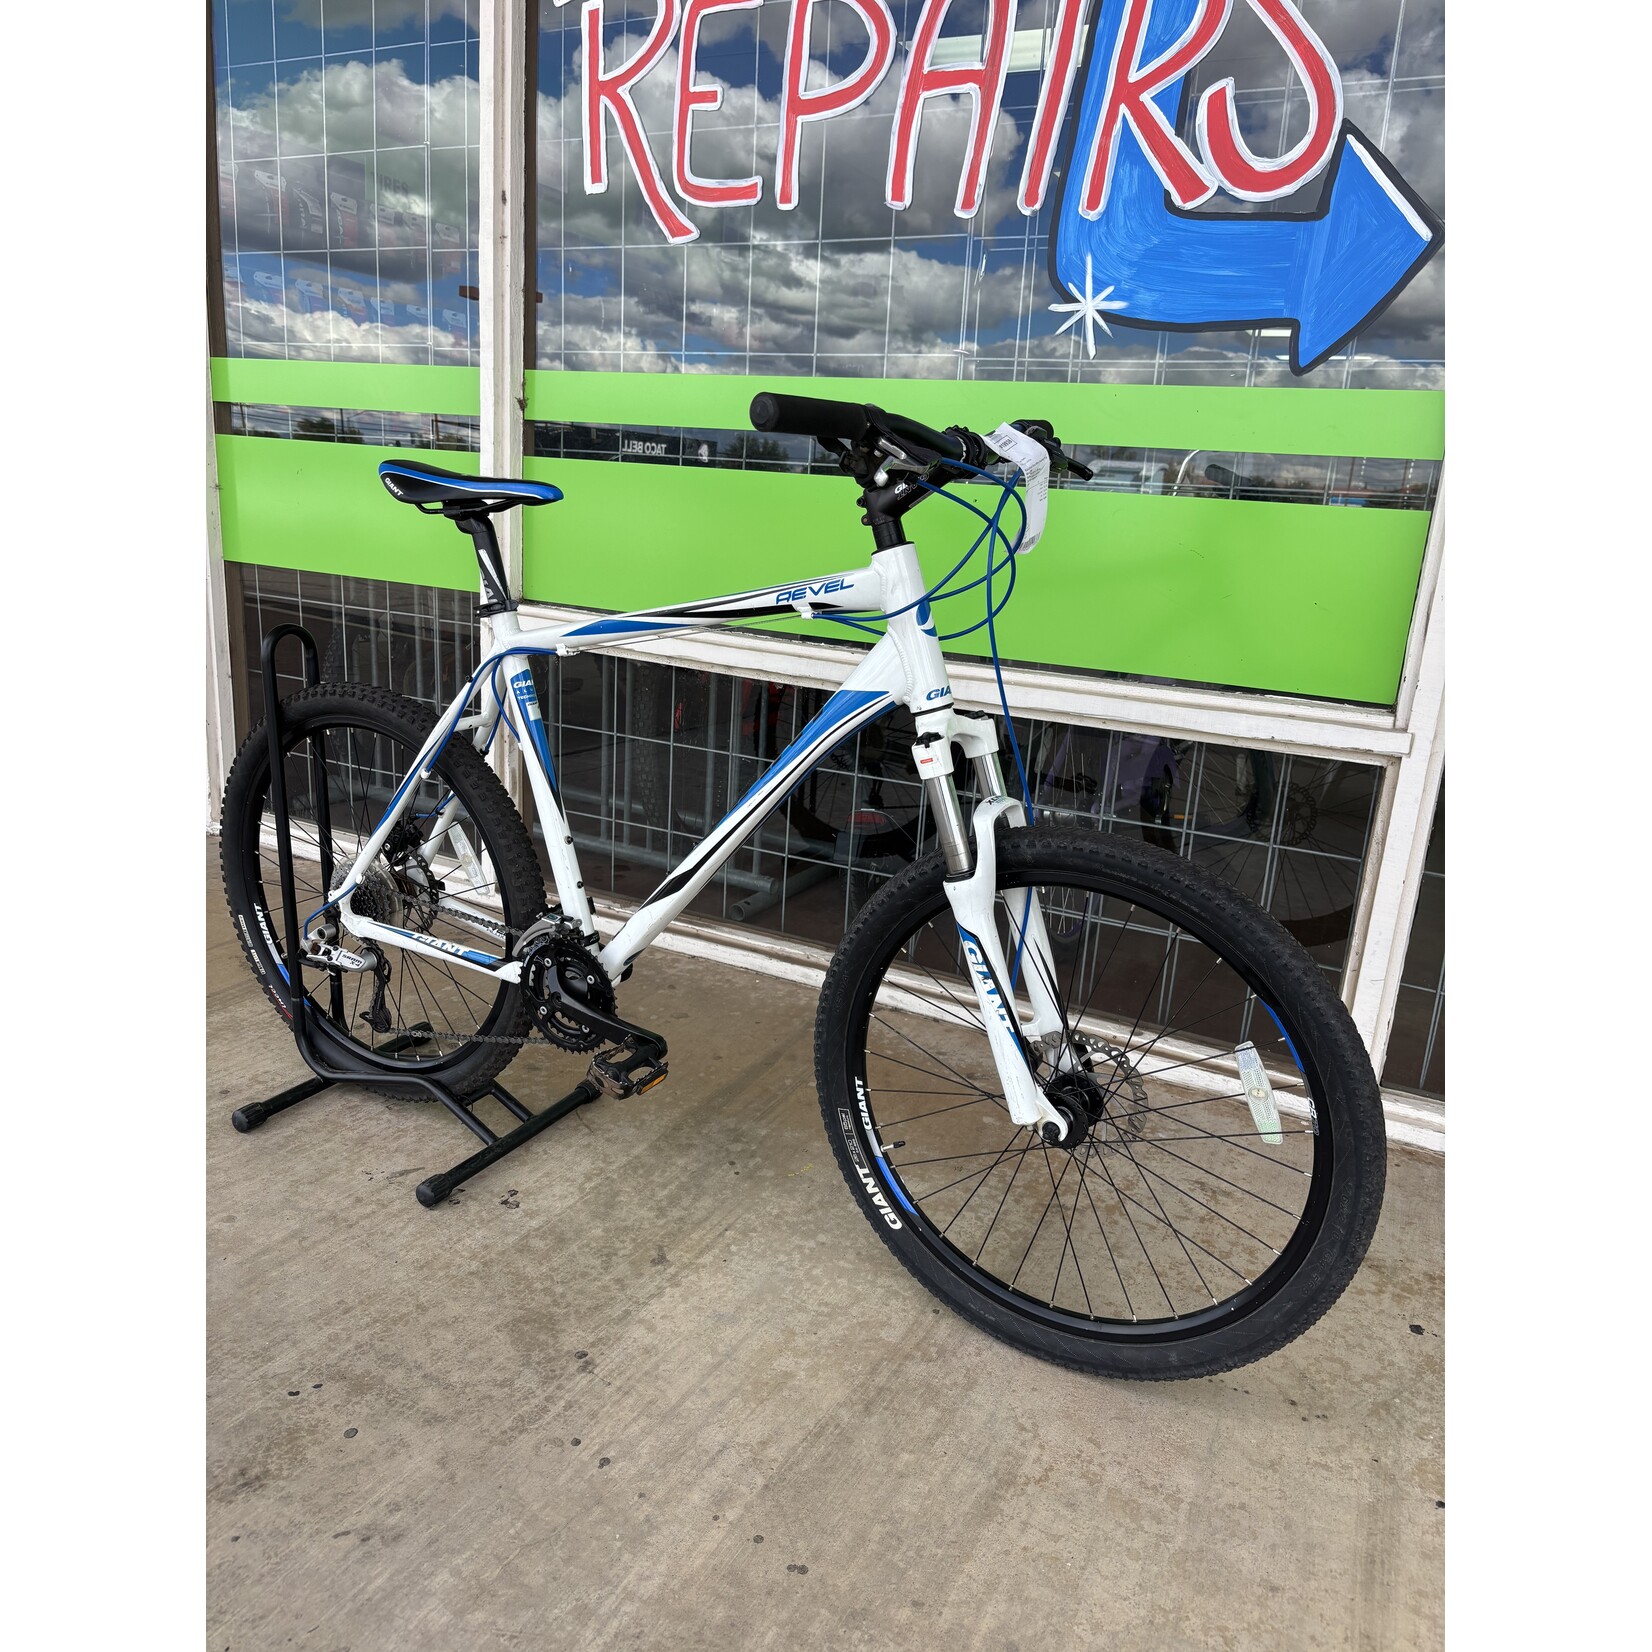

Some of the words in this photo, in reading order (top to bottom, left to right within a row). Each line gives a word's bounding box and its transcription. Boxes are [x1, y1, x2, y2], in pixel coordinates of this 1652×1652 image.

[553, 0, 1345, 243] REPAIRS
[385, 477, 404, 497] GIANT
[775, 578, 854, 604] REVEL
[254, 903, 273, 944] GIANT
[412, 932, 469, 956] GIANT
[962, 940, 1015, 1034] GIANT
[854, 1076, 873, 1131] GIANT
[855, 1164, 903, 1230] GIANT
